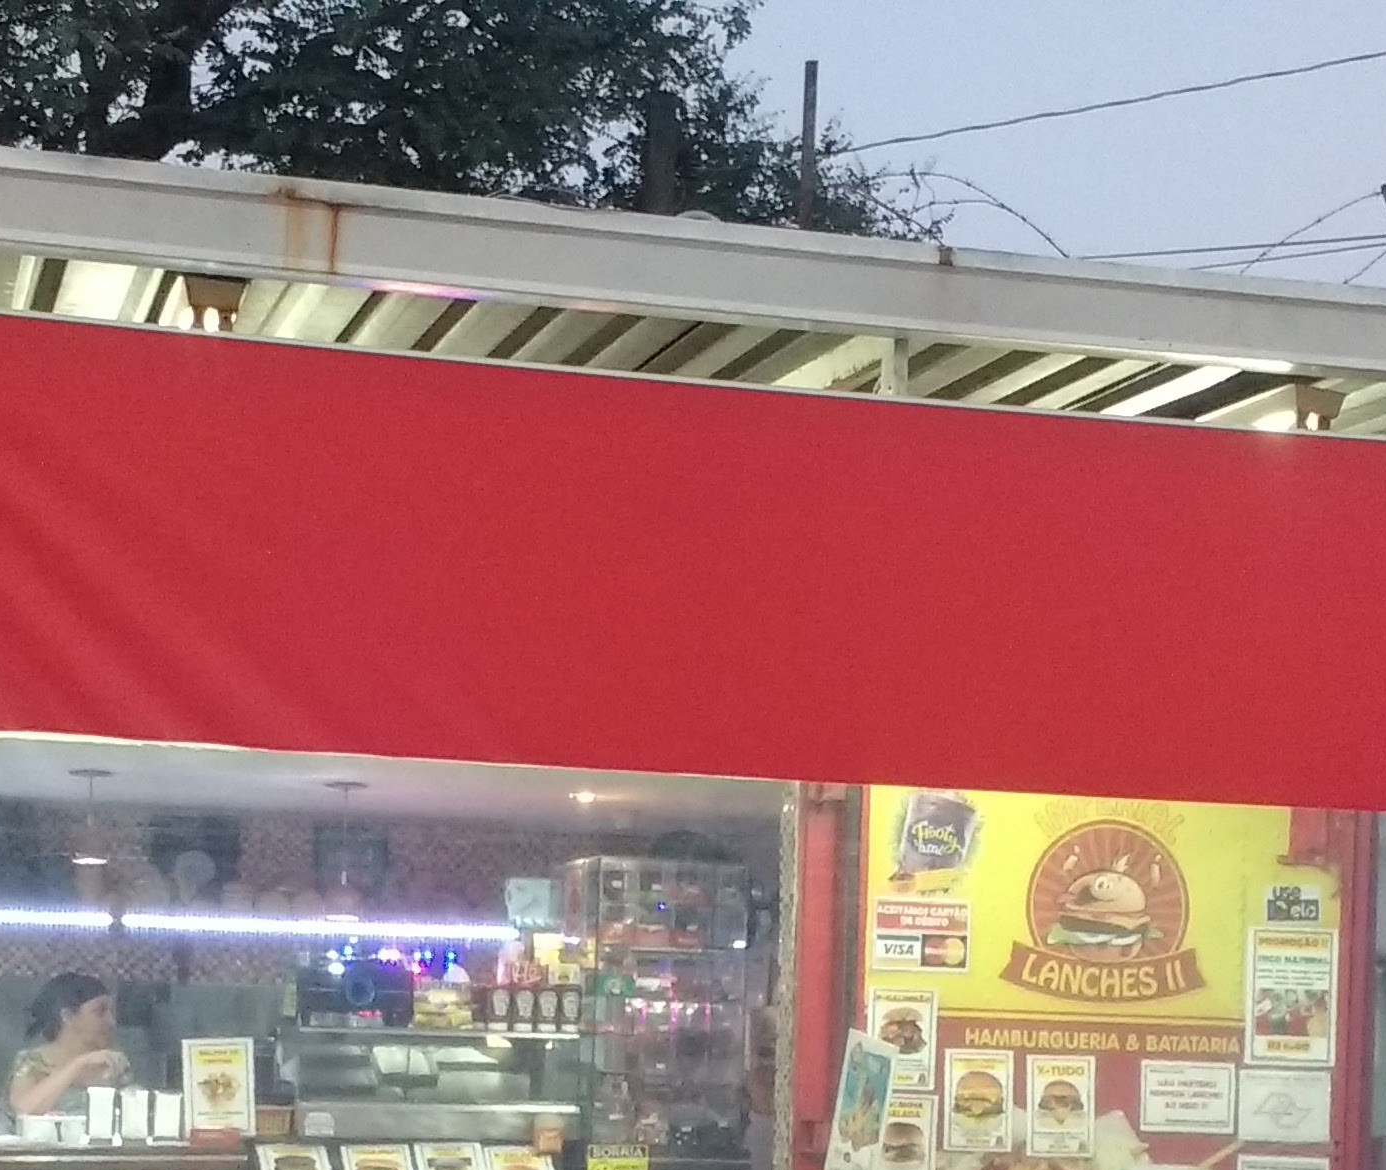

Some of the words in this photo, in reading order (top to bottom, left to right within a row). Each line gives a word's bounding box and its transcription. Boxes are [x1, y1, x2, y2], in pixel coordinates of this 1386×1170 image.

[883, 943, 915, 956] VISA
[1022, 953, 1159, 998] LANCHES
[965, 1027, 1120, 1050] HAMBURGUERIA
[1125, 1033, 1141, 1051] &
[1145, 1034, 1240, 1055] BATATARIA
[1037, 1064, 1085, 1076] X-TUDO
